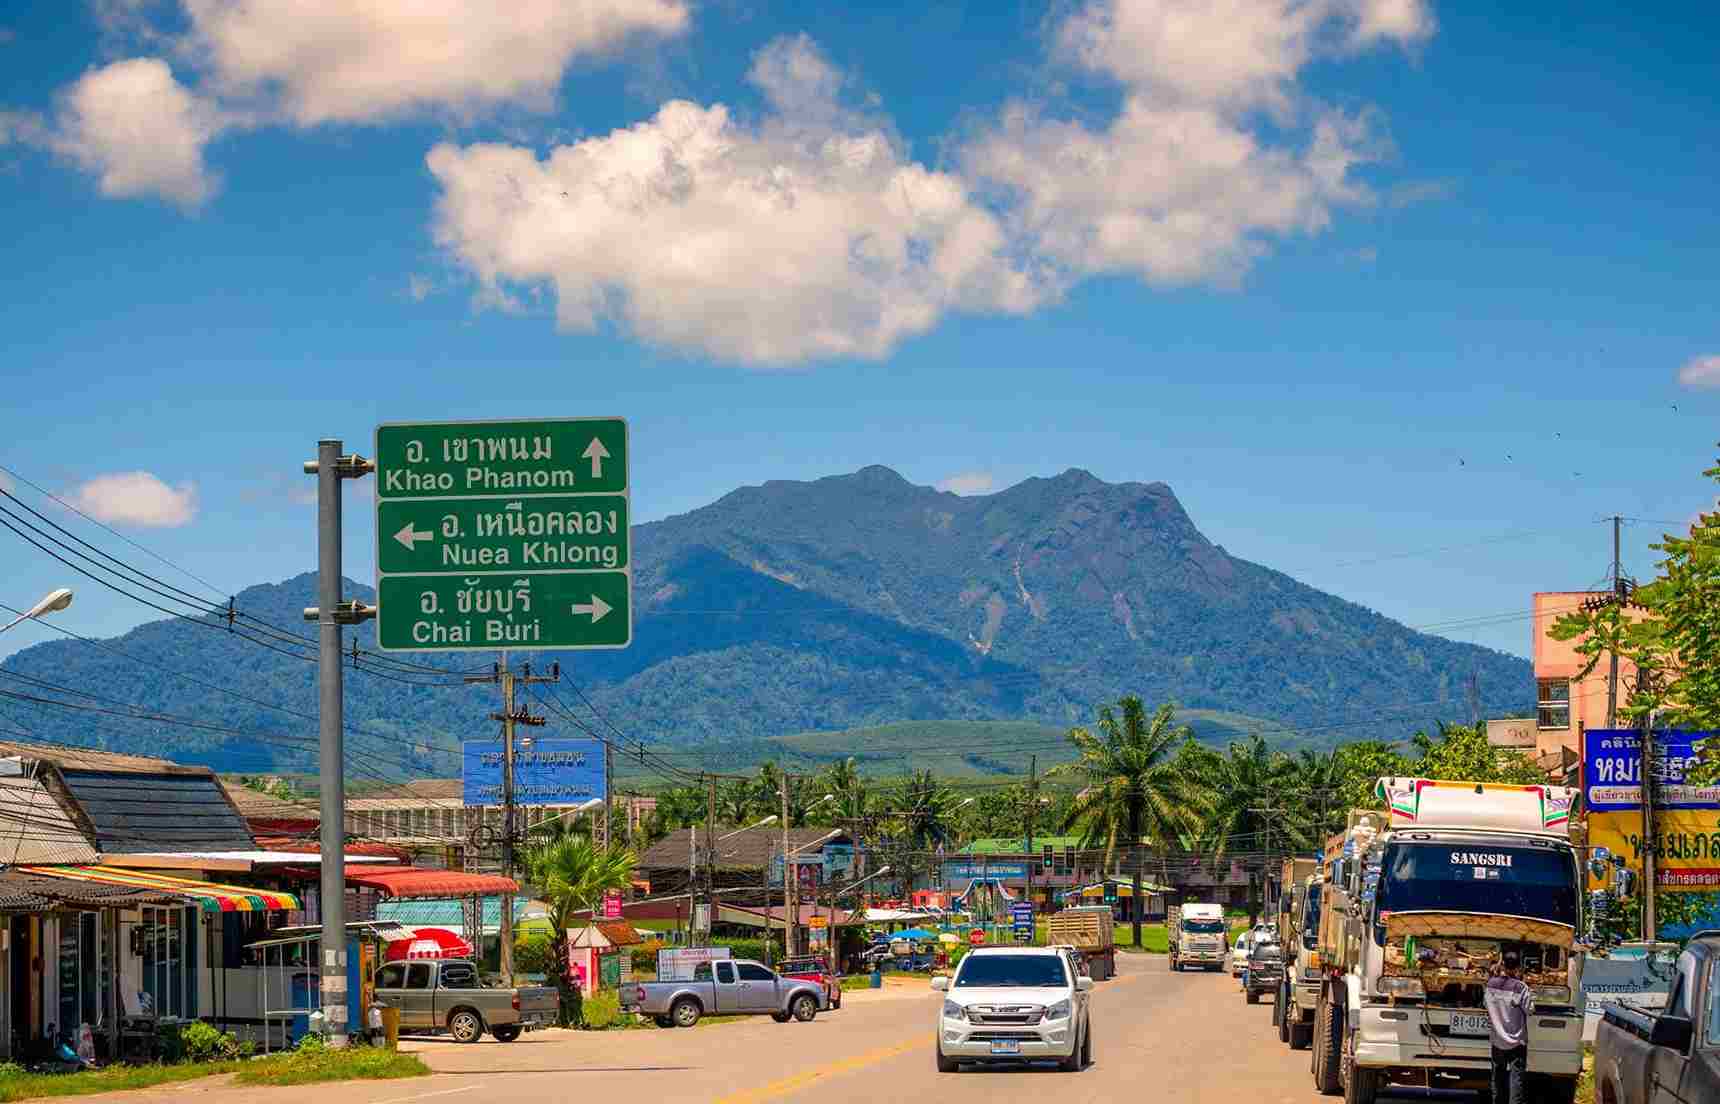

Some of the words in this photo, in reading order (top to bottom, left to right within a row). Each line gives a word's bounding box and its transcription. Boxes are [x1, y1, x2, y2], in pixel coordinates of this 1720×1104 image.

[406, 440, 430, 463] อ.
[443, 436, 552, 462] เขาพนม
[385, 468, 454, 490] Khao
[466, 467, 575, 489] Phanom
[441, 514, 465, 538] อ.
[476, 502, 617, 537] เหนือคลอง
[442, 543, 510, 565] Nuea
[523, 541, 618, 568] Khlong
[420, 590, 444, 614] อ.
[456, 577, 531, 621] ชัยบุรี
[412, 620, 471, 643] Chai
[486, 618, 541, 641] Buri
[1450, 851, 1512, 867] SANGSRI
[1453, 1015, 1489, 1029] 81-012
